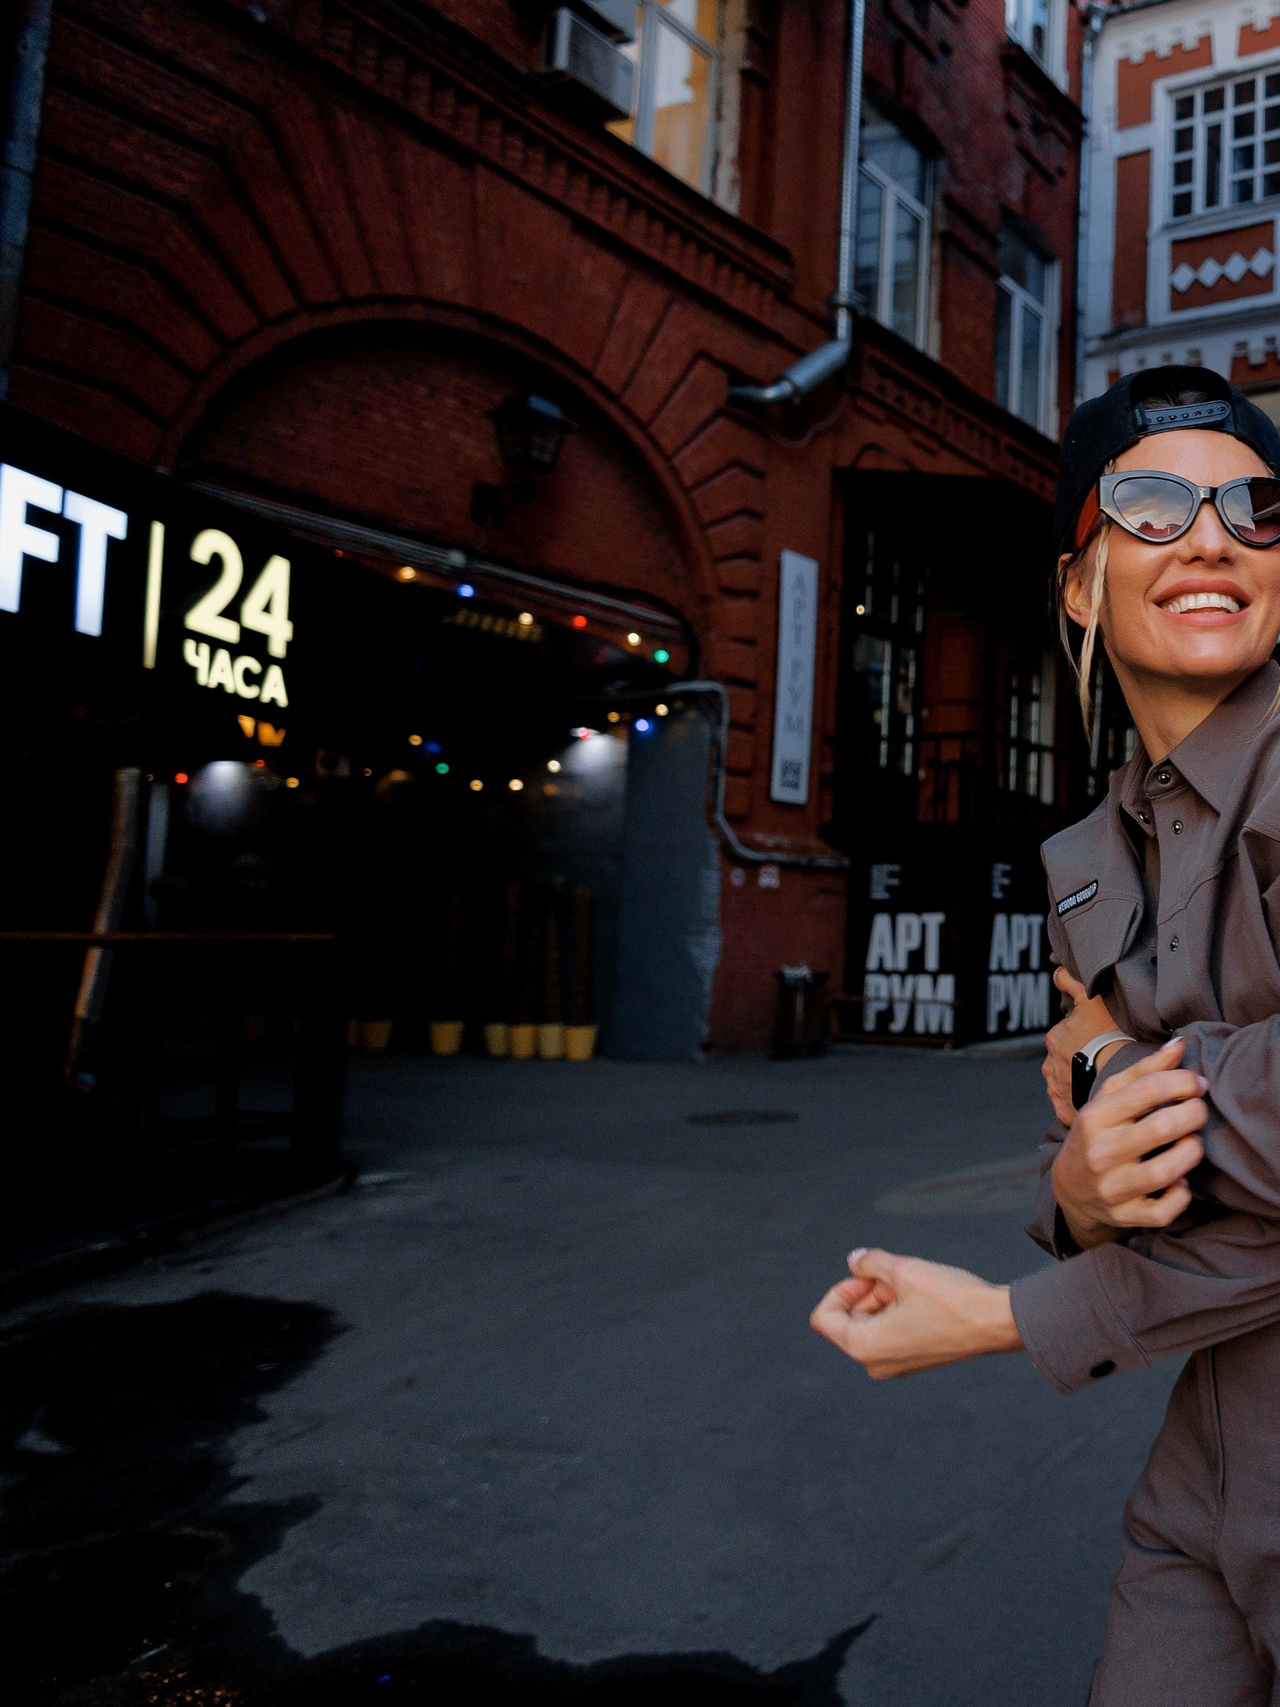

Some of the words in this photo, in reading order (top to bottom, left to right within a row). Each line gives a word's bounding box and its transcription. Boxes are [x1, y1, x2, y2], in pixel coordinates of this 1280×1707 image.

[184, 528, 293, 659] 24
[183, 638, 289, 708] ЧАСА
[865, 912, 947, 973] АРТ
[988, 912, 1045, 972] АРТ
[862, 973, 956, 1035] РУМ
[985, 972, 1050, 1034] РУМ
